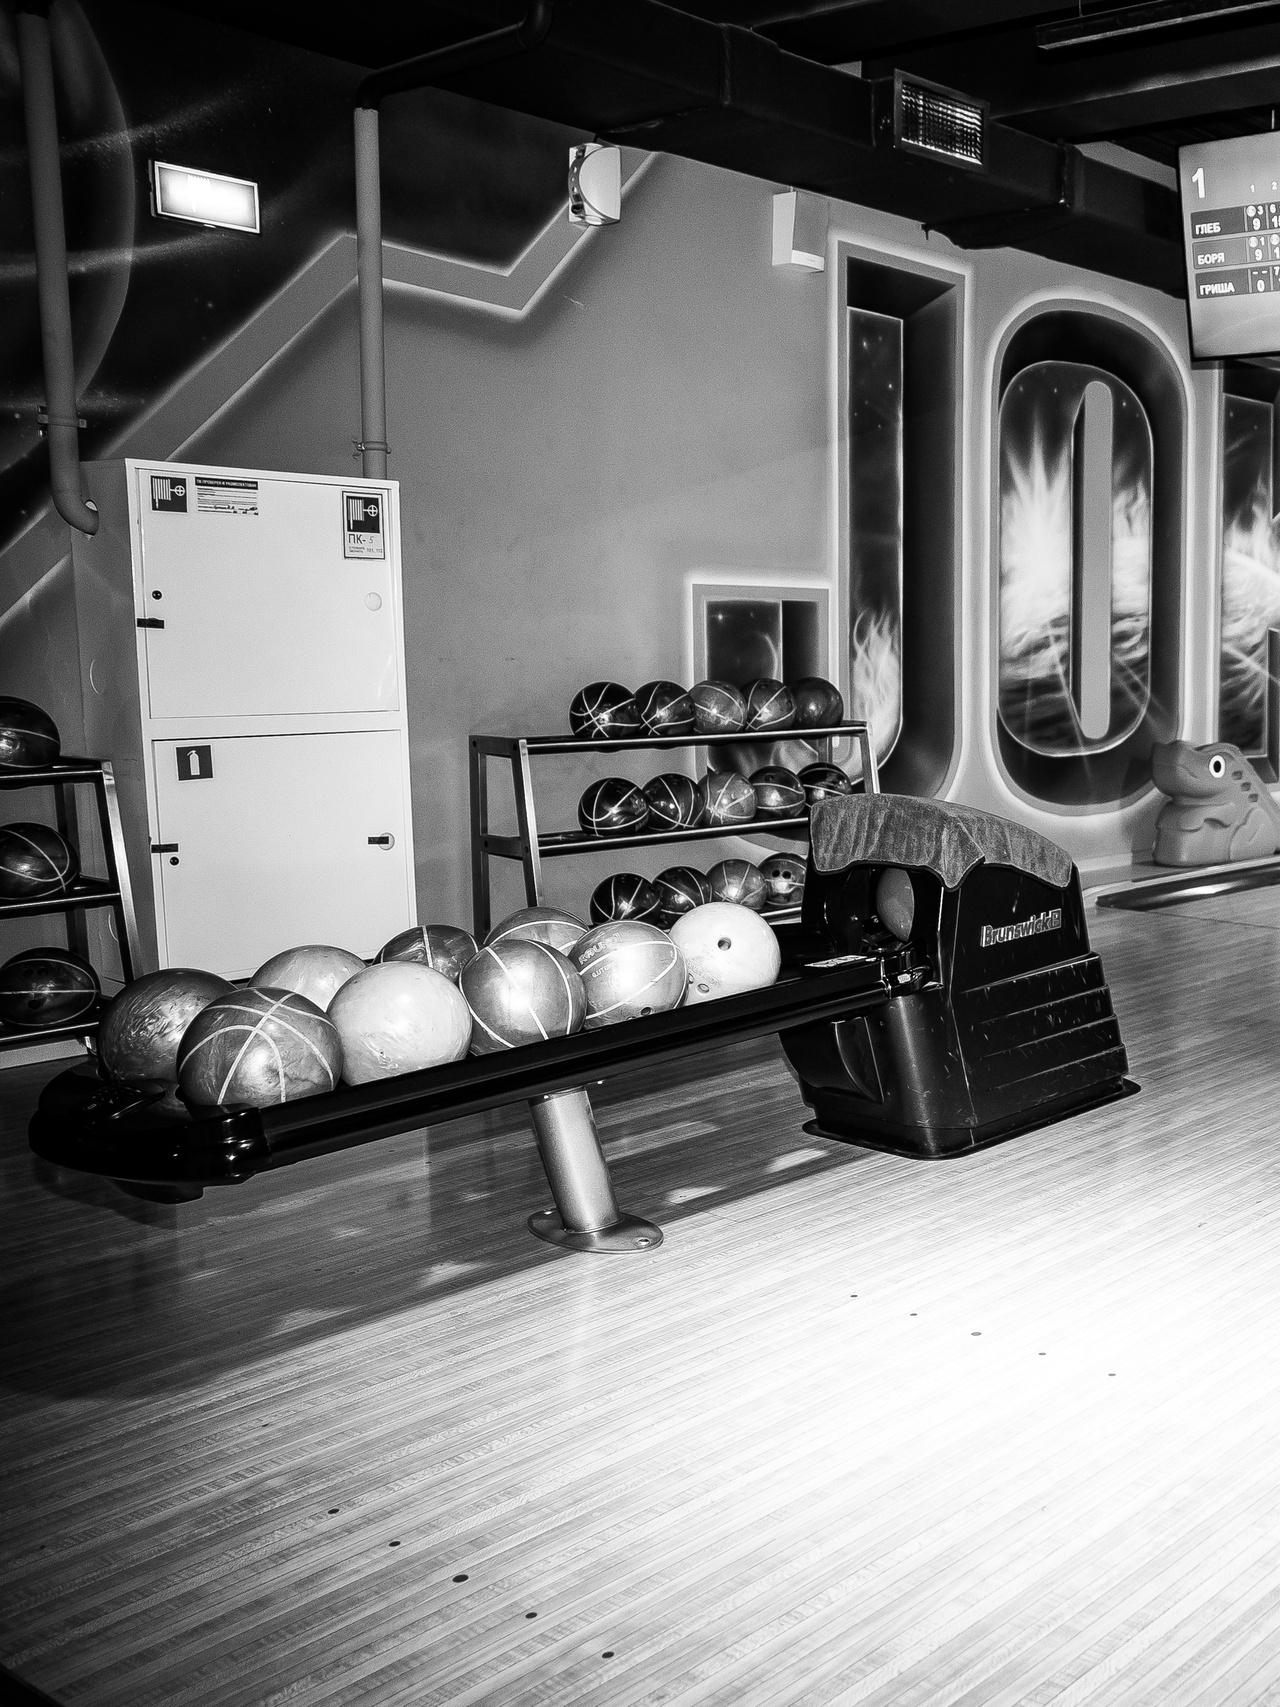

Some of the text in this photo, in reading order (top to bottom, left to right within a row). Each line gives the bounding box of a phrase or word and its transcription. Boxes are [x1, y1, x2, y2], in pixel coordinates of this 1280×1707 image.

[1192, 168, 1205, 198] 1
[1271, 181, 1278, 191] 2
[1196, 222, 1220, 234] ГЛЕБ
[1252, 217, 1261, 231] 9
[1198, 253, 1224, 264] БОРЯ
[1254, 248, 1263, 262] 9
[1200, 282, 1235, 296] ГРИША
[980, 911, 1051, 947] Brunswick
